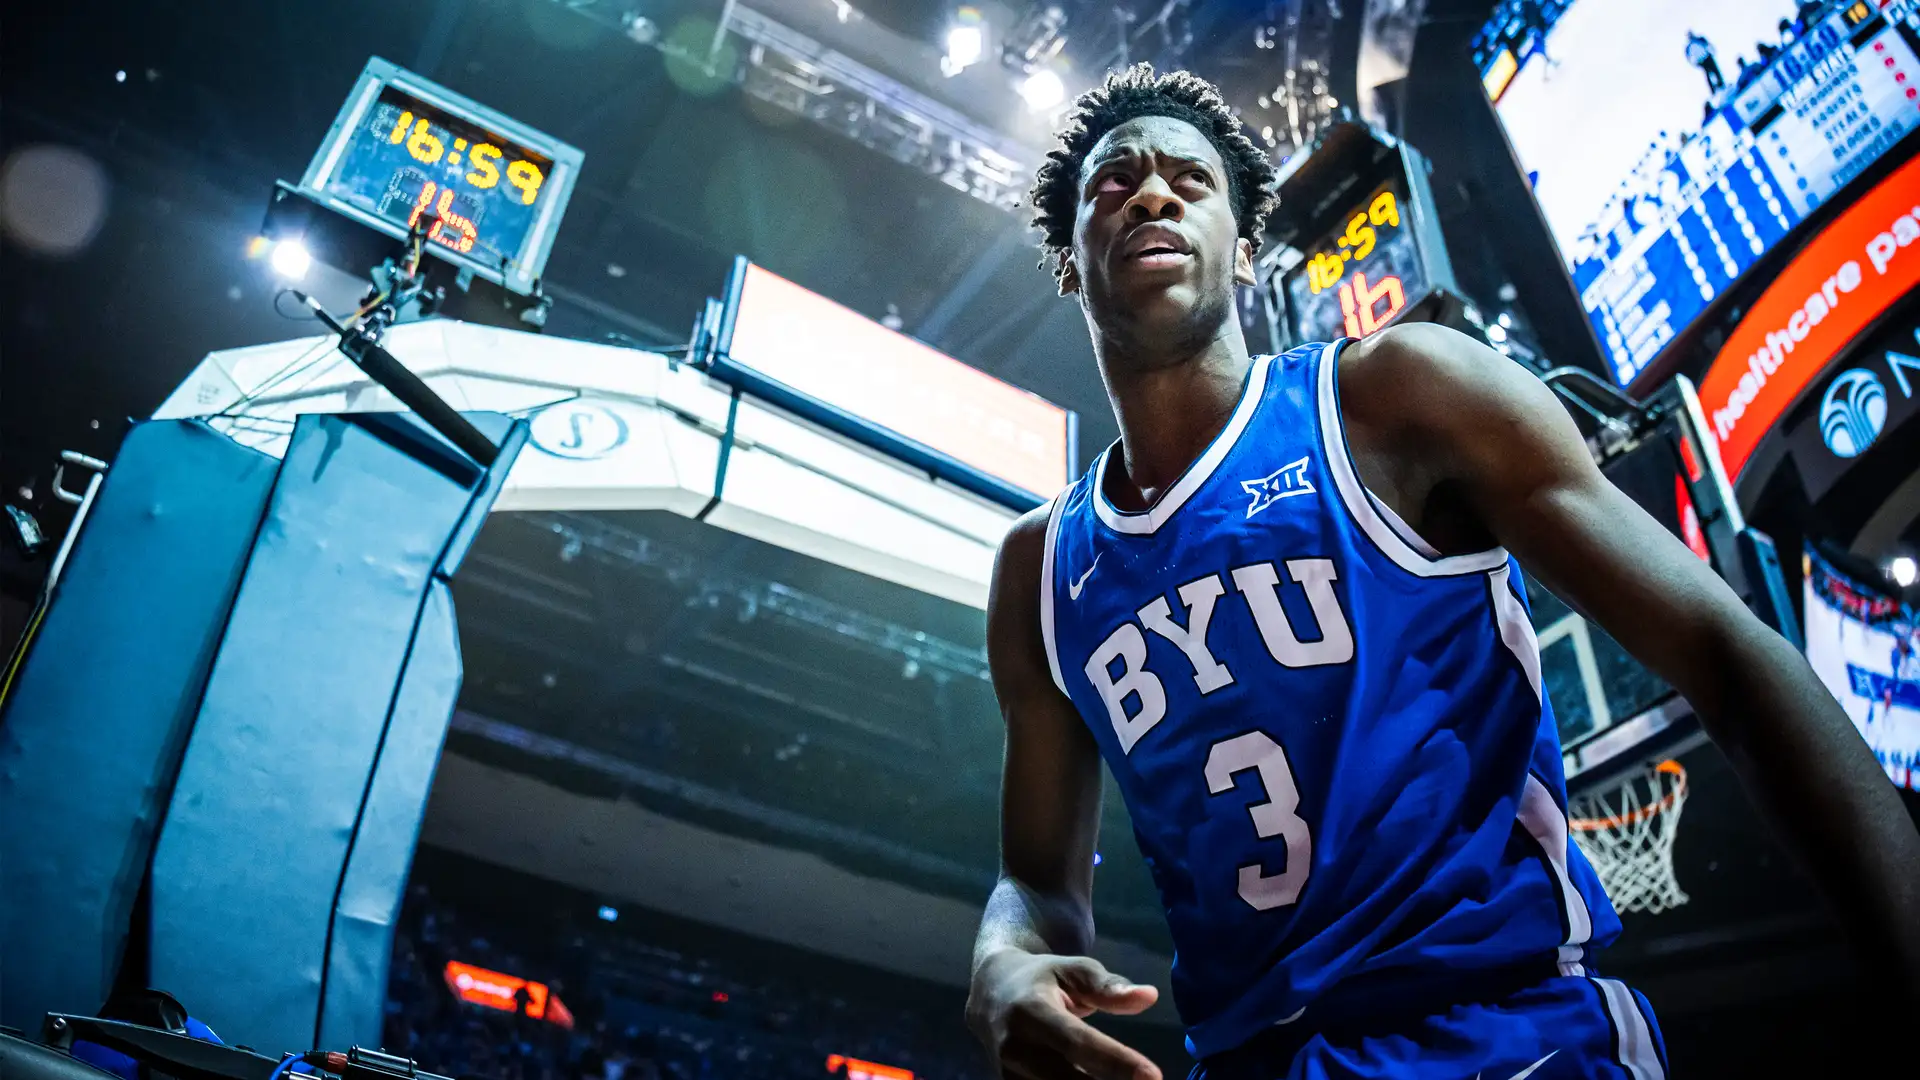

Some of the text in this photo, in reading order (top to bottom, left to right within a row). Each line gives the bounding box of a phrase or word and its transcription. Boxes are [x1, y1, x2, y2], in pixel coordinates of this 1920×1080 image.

[390, 111, 544, 205] 16:59
[1307, 191, 1400, 295] 16:59
[1338, 272, 1407, 340] 16
[1713, 261, 1862, 442] healthcare
[1084, 558, 1355, 756] BYU
[1204, 731, 1312, 911] 3
